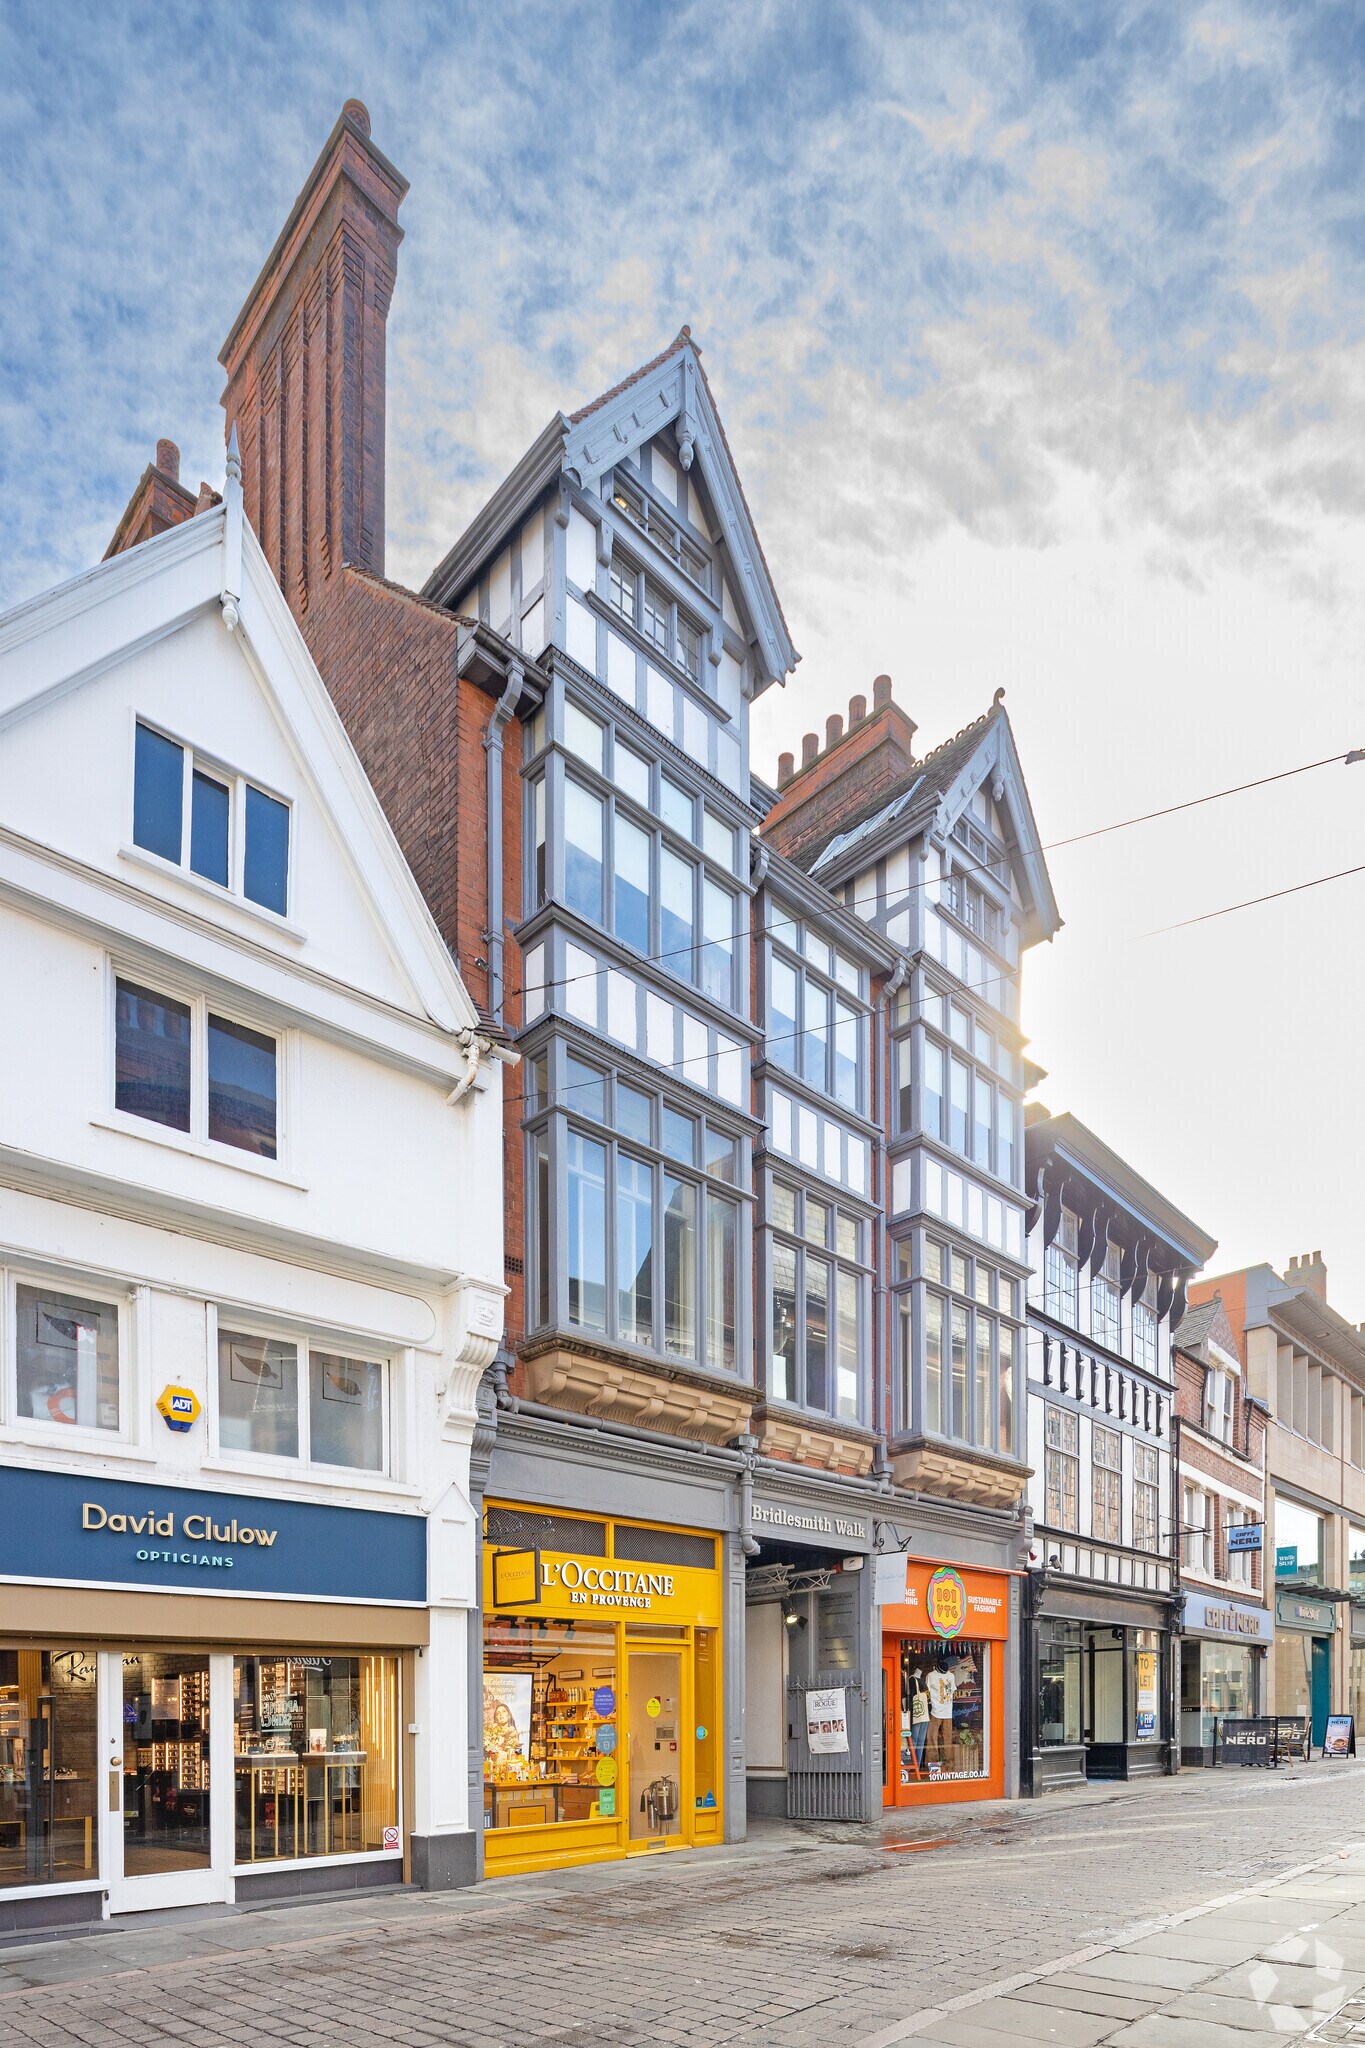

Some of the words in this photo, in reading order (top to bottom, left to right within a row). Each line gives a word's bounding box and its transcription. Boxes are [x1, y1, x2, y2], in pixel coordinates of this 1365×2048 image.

[173, 1398, 192, 1411] ADT
[83, 1503, 174, 1537] David
[183, 1515, 278, 1546] Clulow
[752, 1504, 832, 1533] Bridlesmith
[835, 1519, 866, 1538] Walk
[1231, 1537, 1260, 1546] NERO
[136, 1550, 233, 1567] OPTICIANS
[541, 1561, 675, 1596] L'OCCITANE
[571, 1592, 588, 1604] EN
[591, 1593, 651, 1608] PROVENCE
[904, 1597, 919, 1606] HING
[936, 1587, 957, 1603] 101
[967, 1595, 1003, 1606] SUSTAINABLE
[936, 1603, 958, 1618] VTG
[973, 1604, 997, 1613] FASHION
[1235, 1612, 1260, 1635] NERO
[1140, 1658, 1149, 1669] TO
[1140, 1674, 1152, 1687] LET
[814, 1699, 837, 1708] ROGUE
[1226, 1736, 1267, 1745] NERO
[929, 1770, 989, 1781] 101VINTAGE.CO.UK
